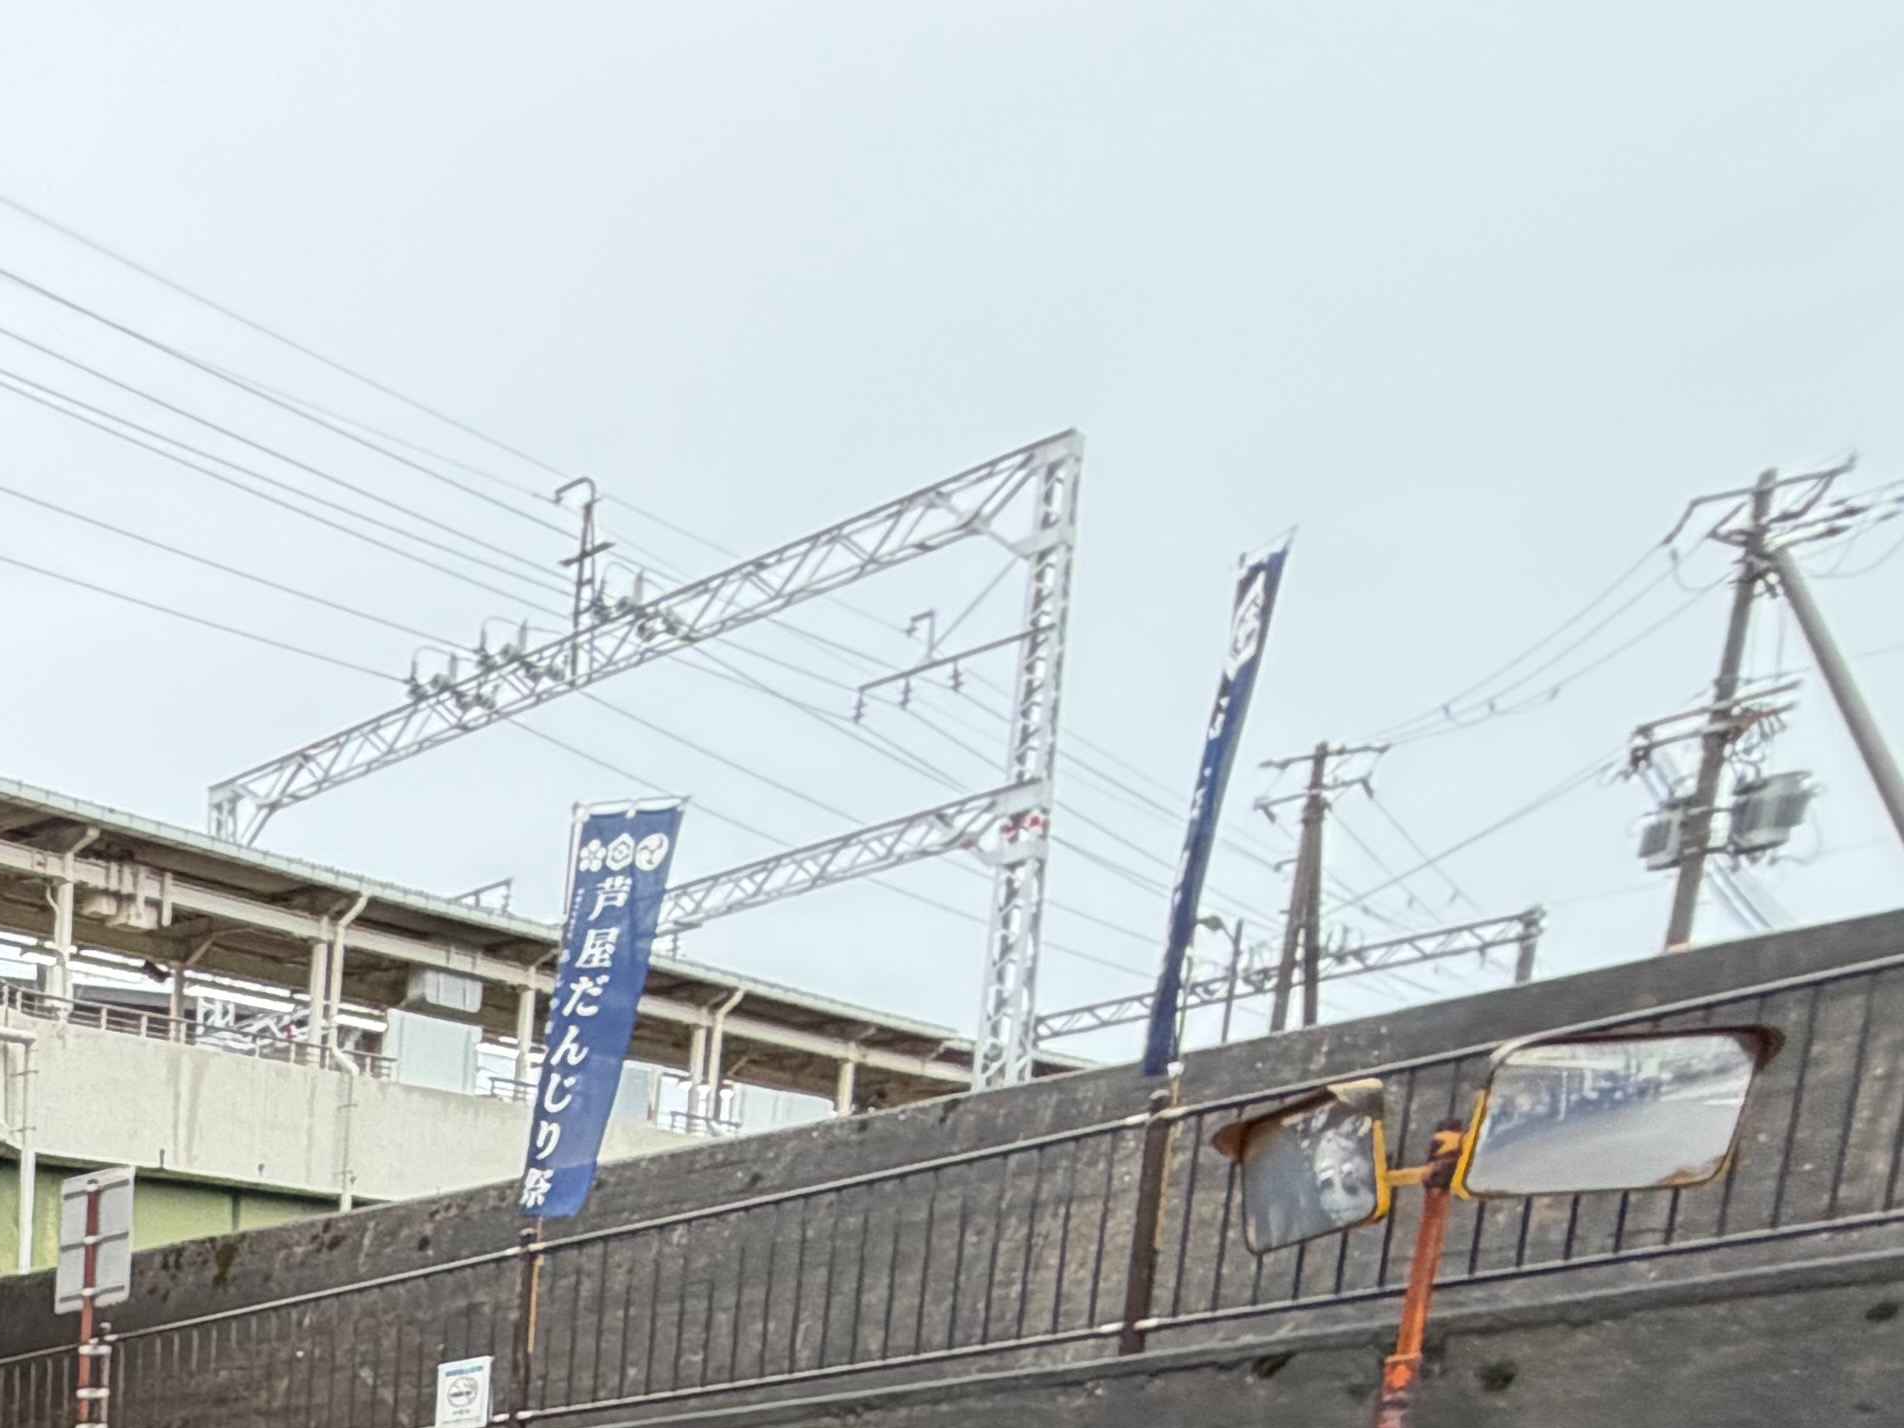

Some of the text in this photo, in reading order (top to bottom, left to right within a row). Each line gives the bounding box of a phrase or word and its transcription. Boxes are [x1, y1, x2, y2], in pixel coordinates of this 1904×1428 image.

[520, 876, 632, 1208] 芦屋だんじり祭
